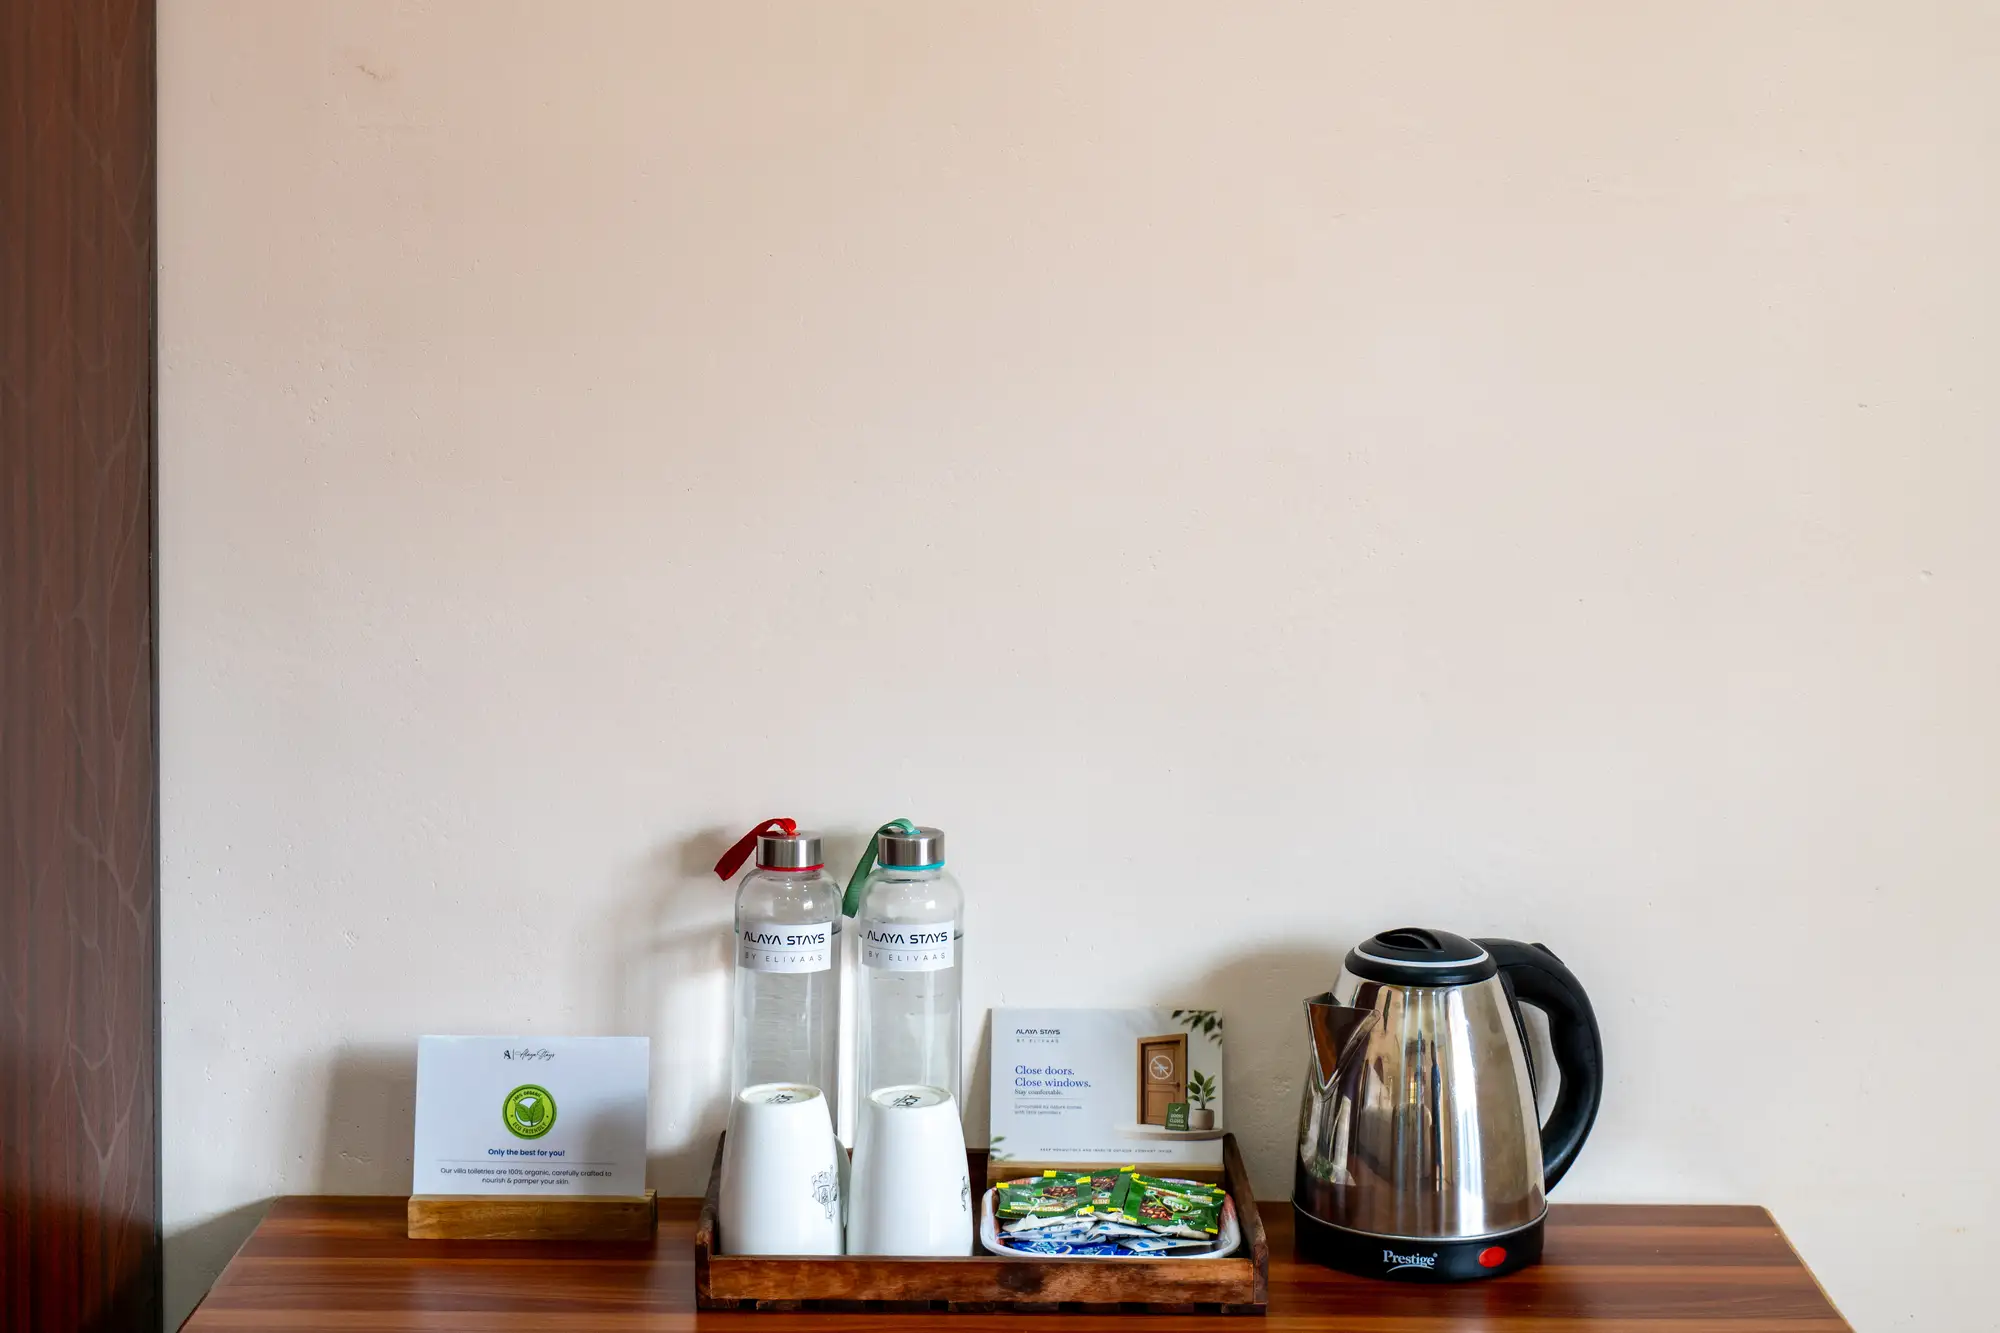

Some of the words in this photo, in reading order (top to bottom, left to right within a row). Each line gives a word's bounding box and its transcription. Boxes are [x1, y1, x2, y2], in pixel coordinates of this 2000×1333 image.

[744, 931, 782, 946] ALAYA
[786, 933, 825, 946] STAYS
[867, 930, 905, 945] ALAYA
[909, 931, 948, 945] STAYS
[744, 951, 757, 960] BY
[765, 954, 823, 963] ELIVAAS
[868, 950, 880, 959] BY
[888, 952, 946, 962] ELIVAAS
[1014, 1064, 1042, 1075] Close
[1044, 1065, 1075, 1075] doors.
[1014, 1077, 1042, 1087] Close
[1044, 1078, 1092, 1088] windows.
[1014, 1088, 1027, 1096] Stay
[488, 1148, 505, 1157] Only
[548, 1150, 565, 1158] you!
[524, 1169, 551, 1177] organic,
[1162, 1197, 1190, 1212] BRU
